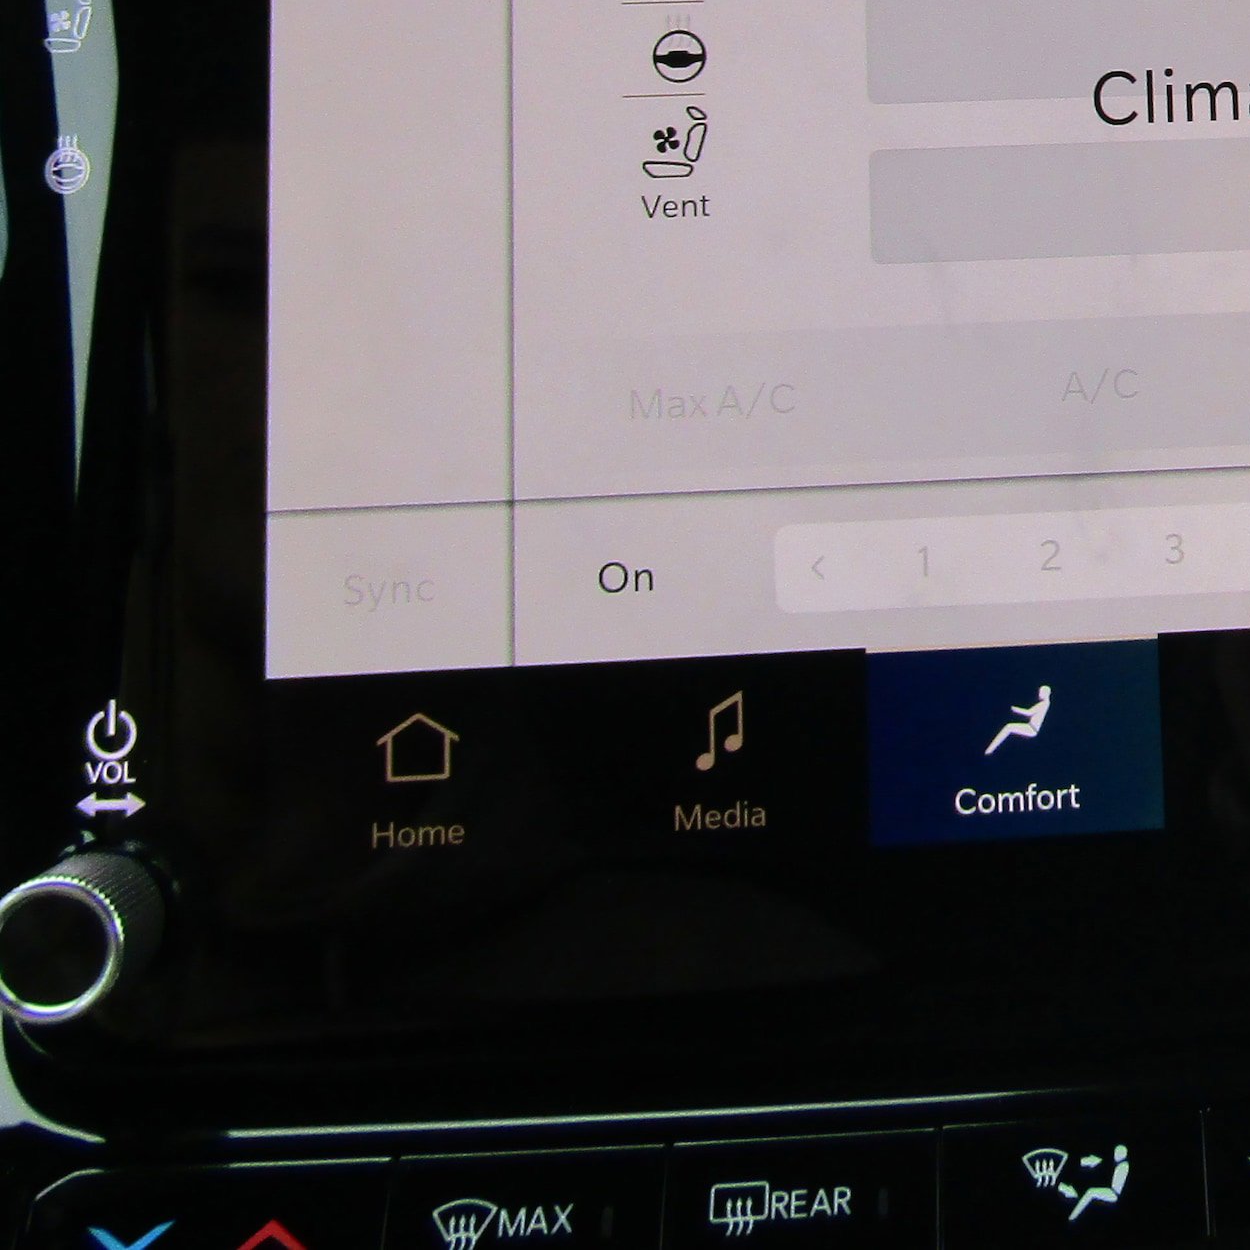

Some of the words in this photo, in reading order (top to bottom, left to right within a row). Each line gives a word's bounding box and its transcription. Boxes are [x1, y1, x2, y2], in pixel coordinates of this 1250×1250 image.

[640, 194, 710, 219] Vent
[629, 388, 708, 420] Max
[716, 382, 796, 420] A/C
[1061, 367, 1139, 405] A/C
[917, 546, 930, 579] 1
[1040, 539, 1062, 572] 2
[1165, 532, 1185, 565] 3
[343, 573, 434, 613] Sync
[598, 561, 654, 594] On
[85, 760, 137, 785] VOL
[954, 782, 1081, 816] Comfort
[674, 801, 766, 831] Media
[372, 822, 465, 848] Home
[770, 1186, 852, 1219] REAR
[497, 1204, 573, 1237] MAX
